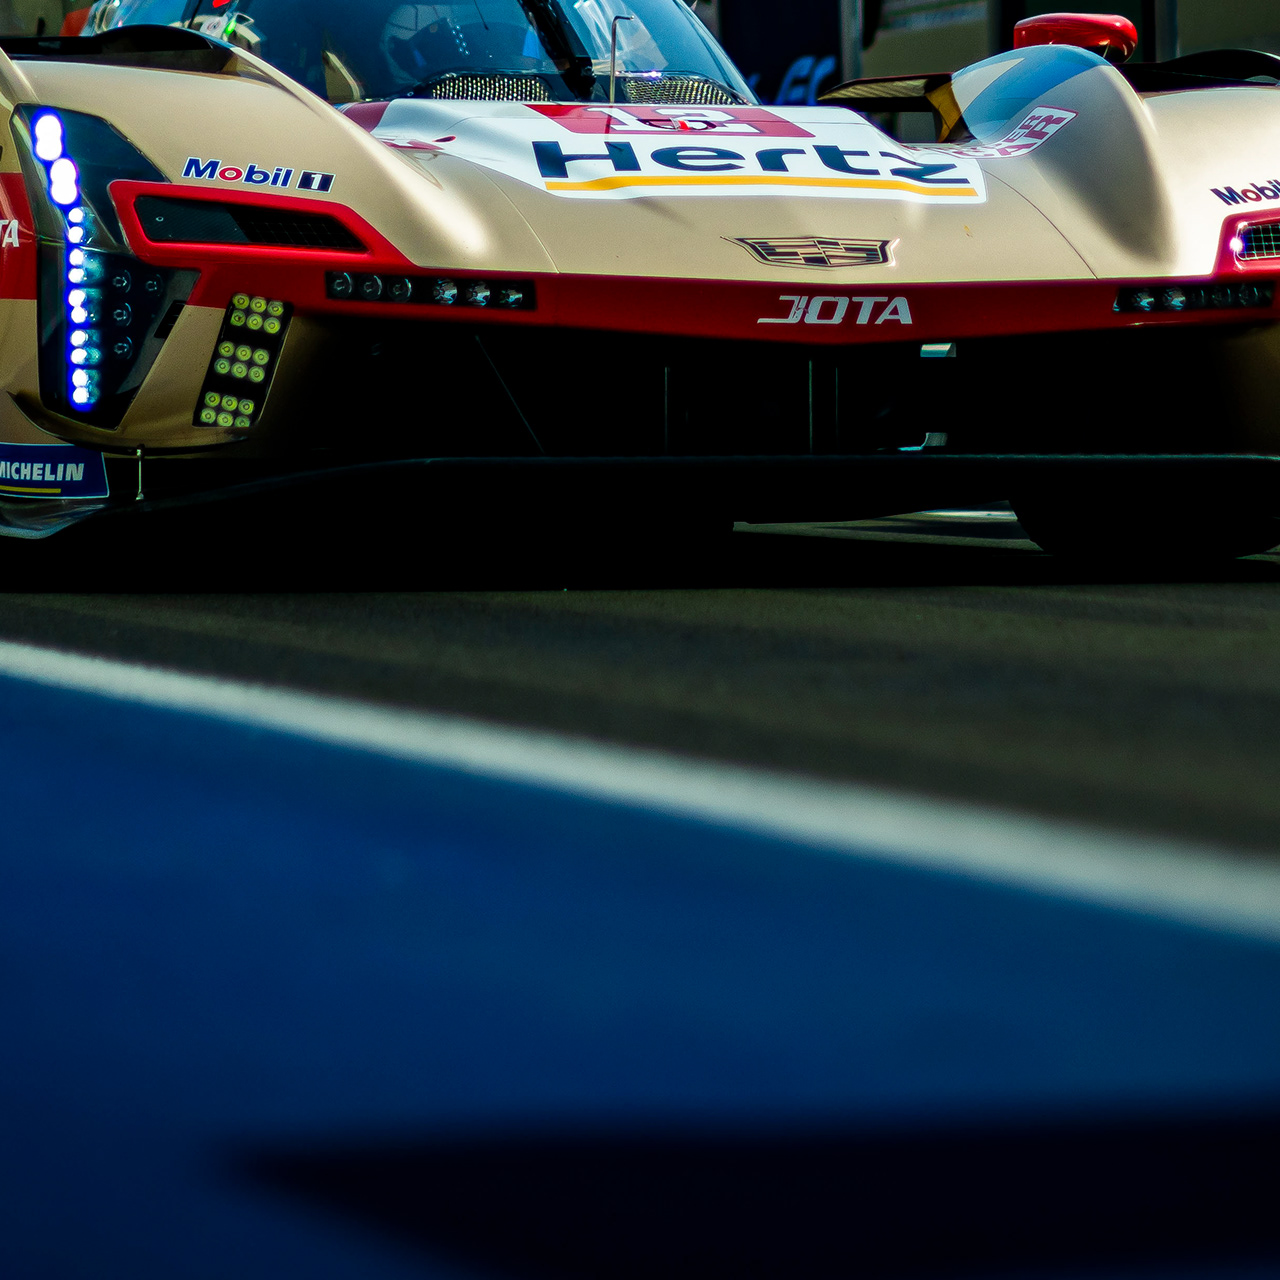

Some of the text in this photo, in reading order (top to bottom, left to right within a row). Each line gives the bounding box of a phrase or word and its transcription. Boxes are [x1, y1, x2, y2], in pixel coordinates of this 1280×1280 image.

[587, 105, 766, 134] 12
[182, 157, 294, 188] Mobil
[531, 141, 971, 185] Hertz
[756, 294, 913, 325] JOTA
